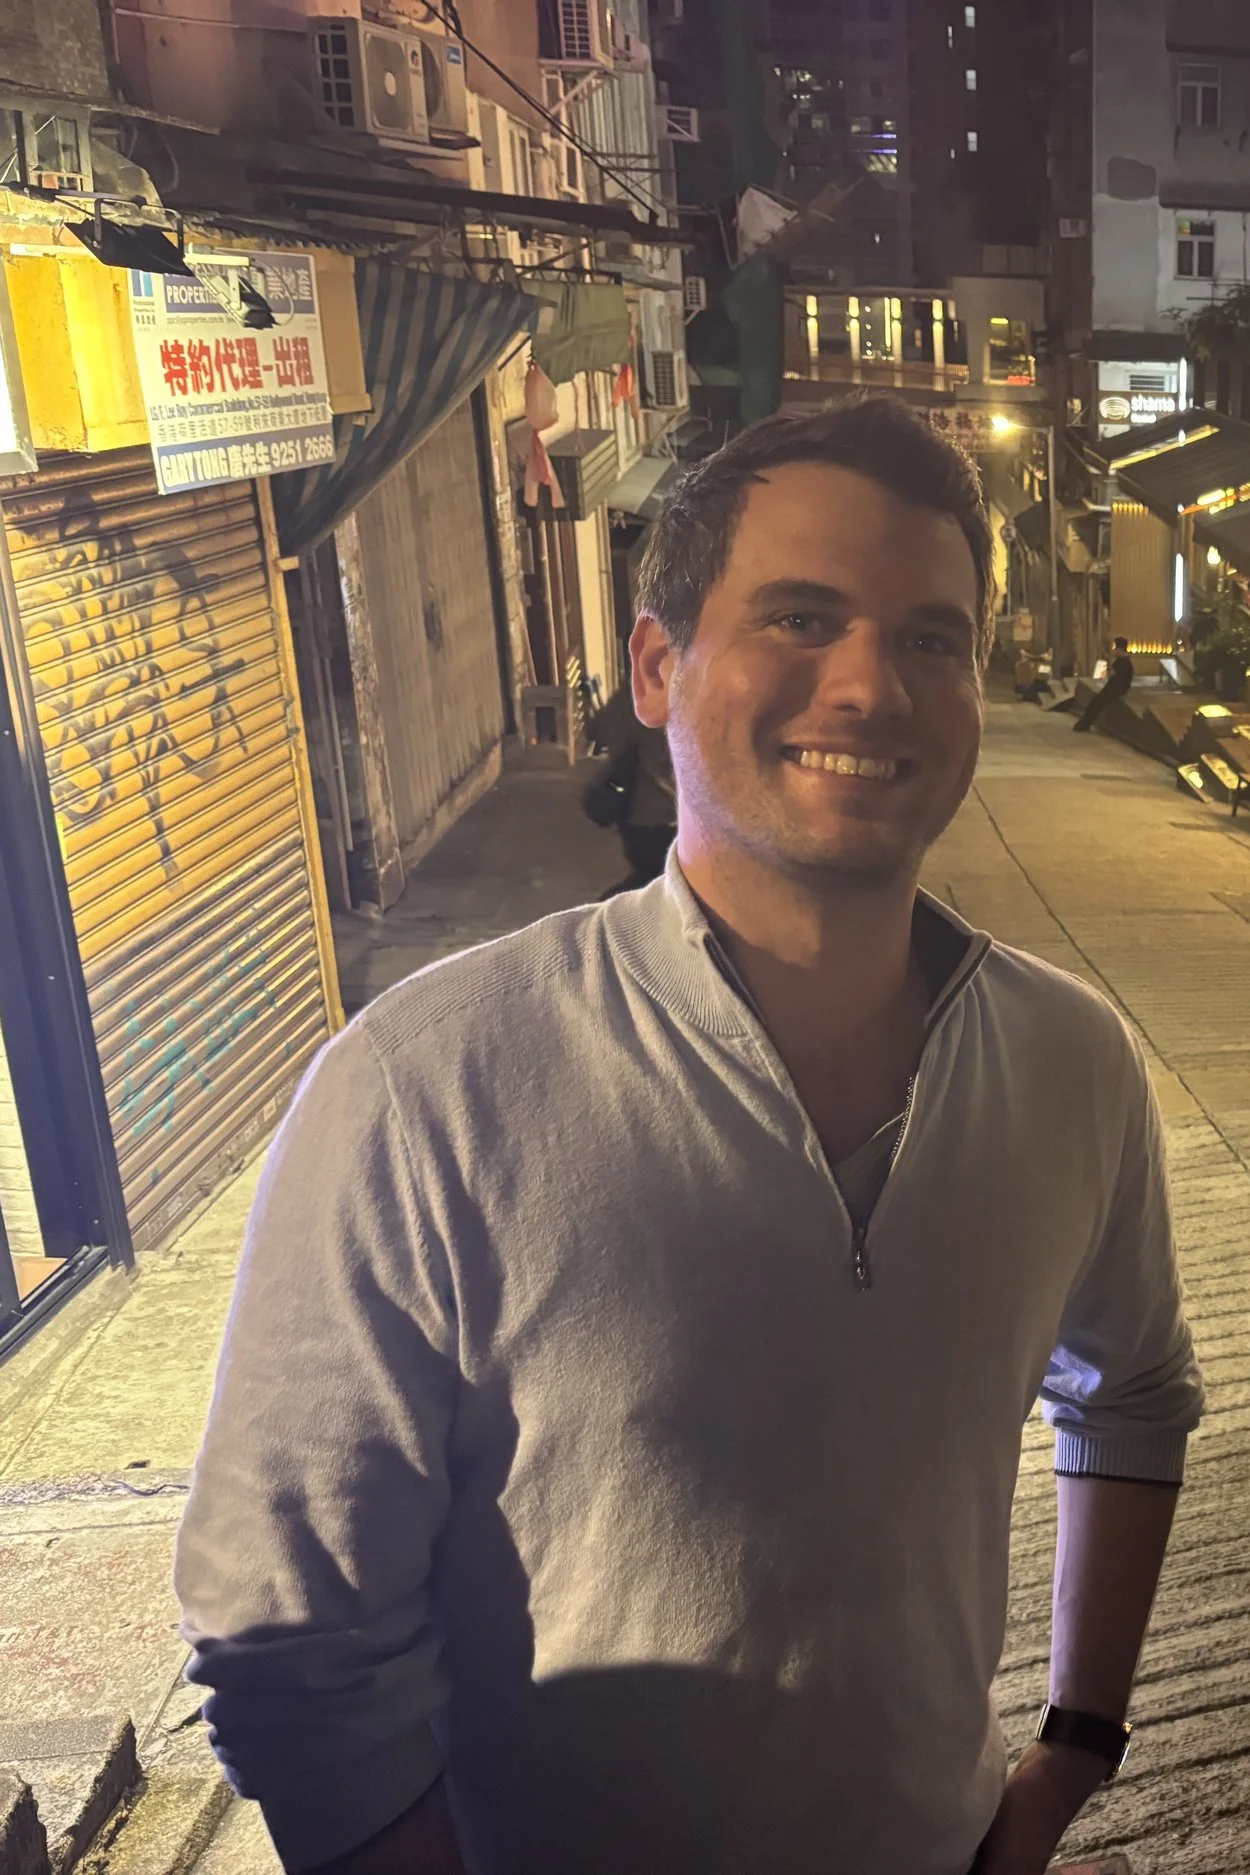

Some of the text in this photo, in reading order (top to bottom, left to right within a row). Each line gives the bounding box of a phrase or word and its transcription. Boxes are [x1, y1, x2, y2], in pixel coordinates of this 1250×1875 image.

[160, 451, 195, 488] GARY
[193, 447, 229, 481] TONG
[271, 440, 303, 467] 9251
[304, 434, 333, 461] 2666
